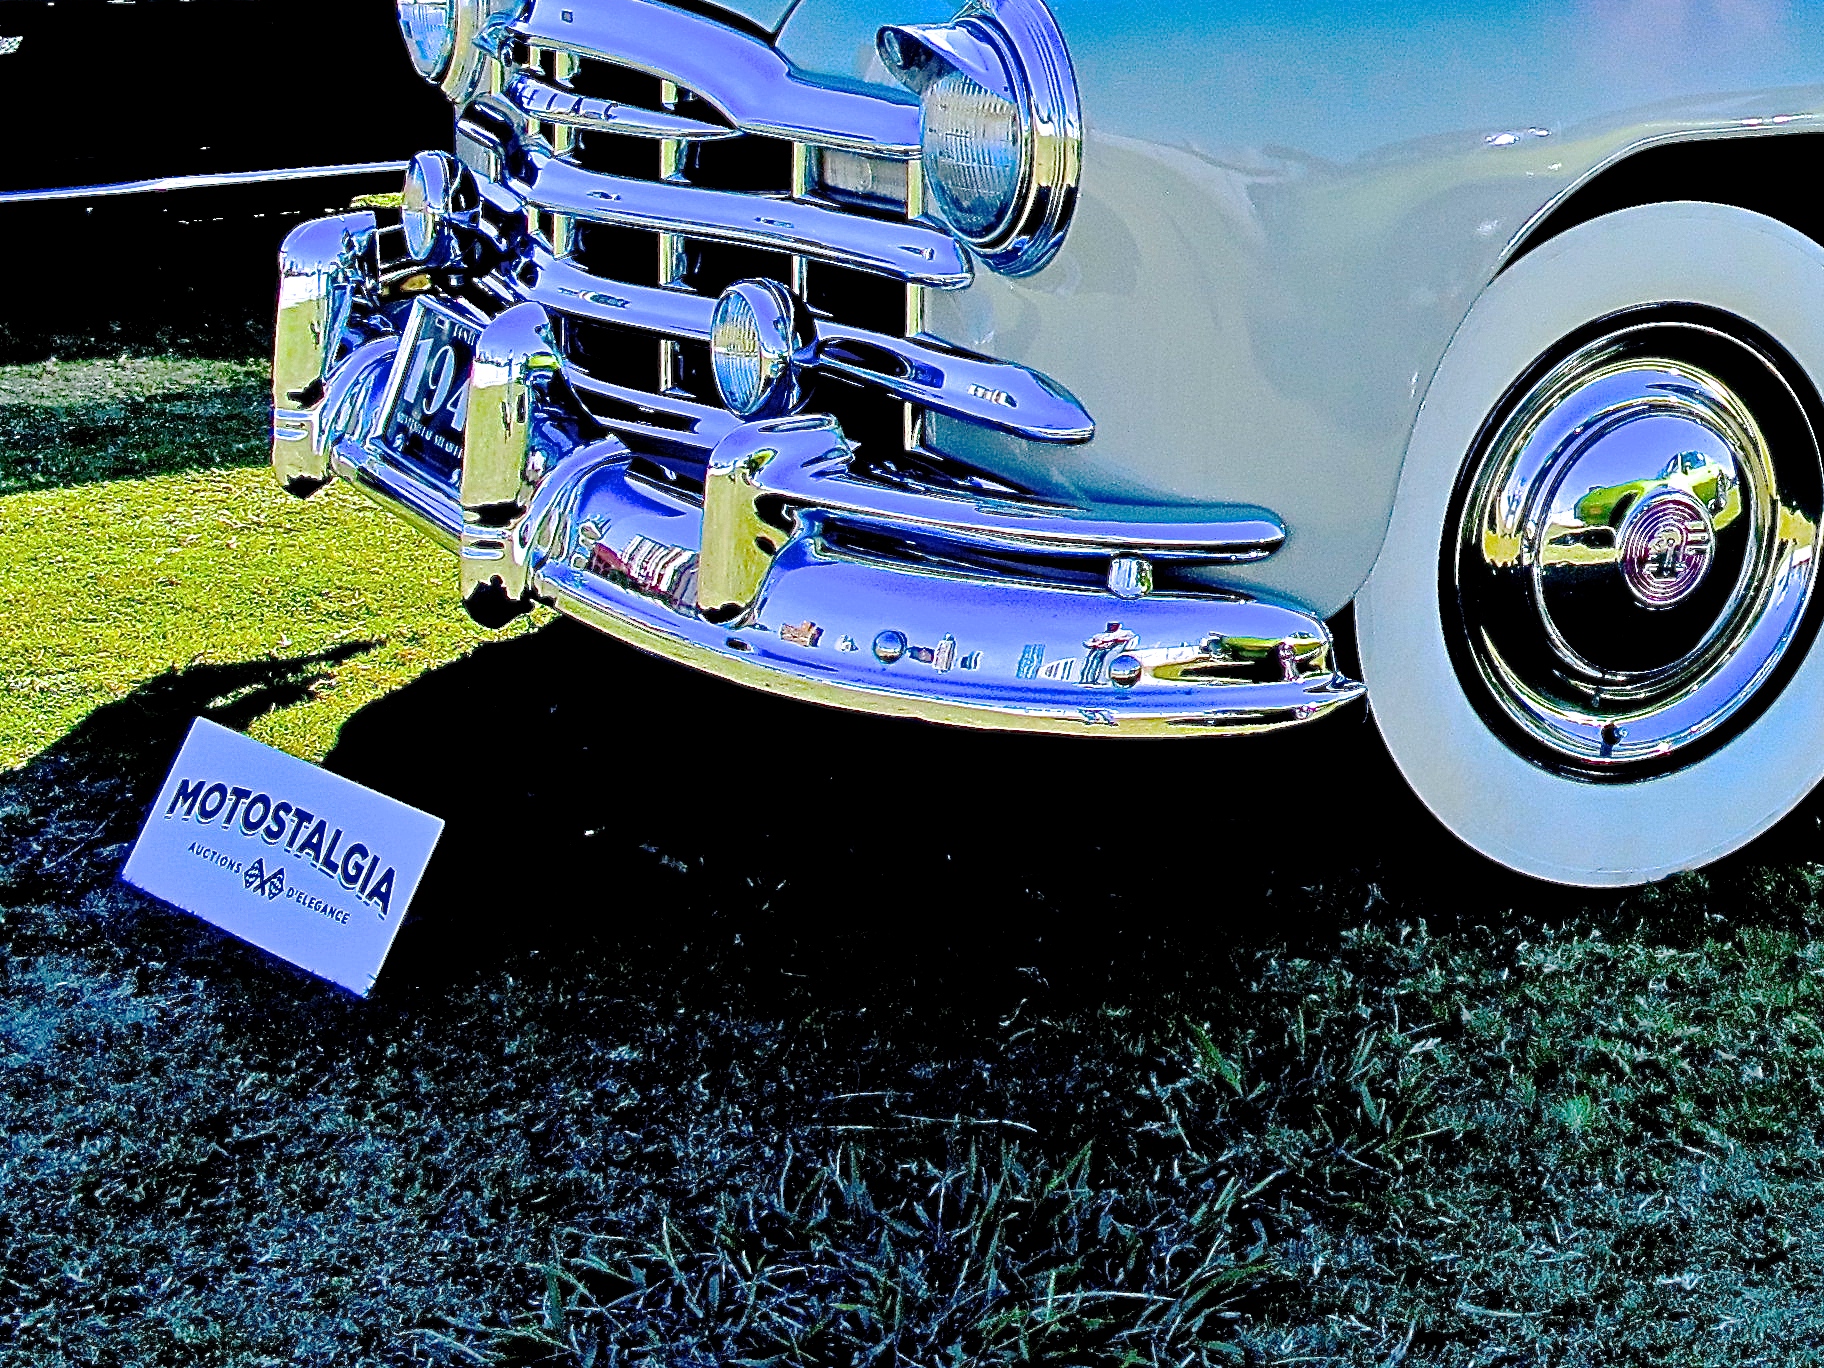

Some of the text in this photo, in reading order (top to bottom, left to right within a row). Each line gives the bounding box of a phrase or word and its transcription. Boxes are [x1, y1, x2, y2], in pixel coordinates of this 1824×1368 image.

[165, 779, 396, 919] MOTOSTALGIA
[188, 841, 351, 924] AUCTIONS D'ELEGANCE
